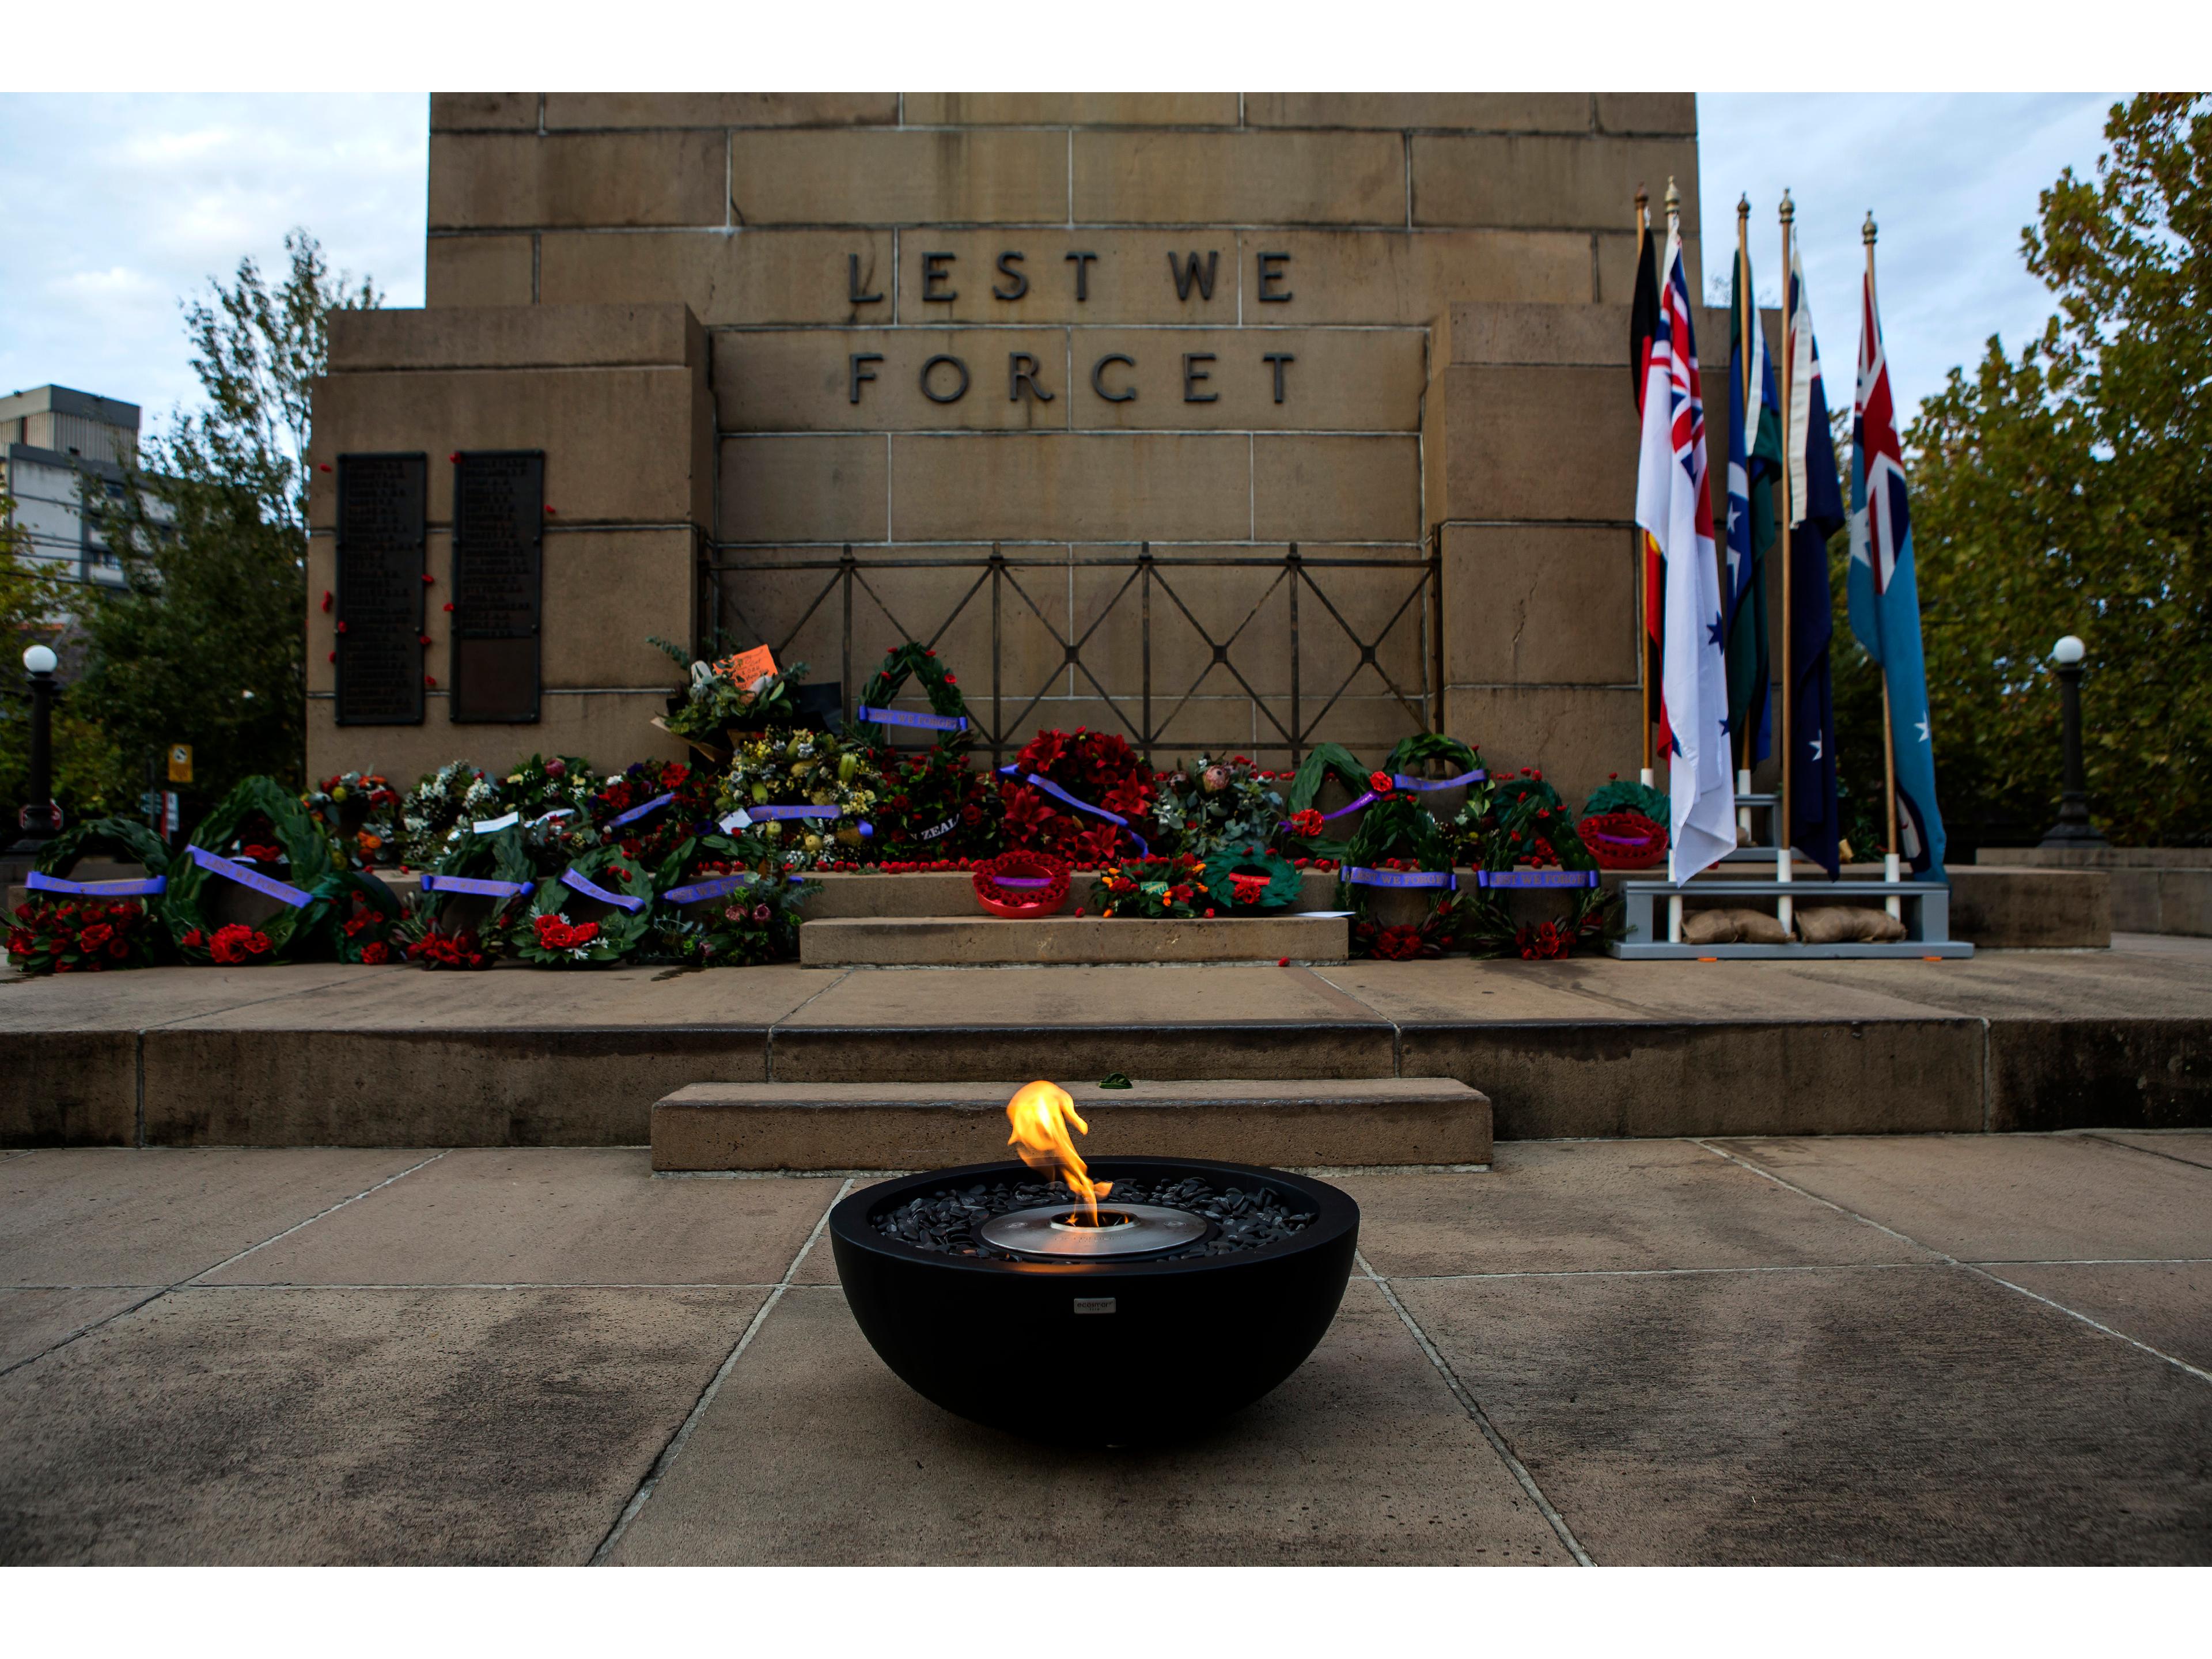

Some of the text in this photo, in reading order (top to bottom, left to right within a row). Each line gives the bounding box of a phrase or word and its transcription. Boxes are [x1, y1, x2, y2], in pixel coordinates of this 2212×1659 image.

[848, 250, 1294, 303] LEST WE
[849, 352, 1296, 404] FORGET
[921, 813, 960, 840] ZEAL
[696, 884, 717, 896] WE
[721, 878, 743, 893] FOR
[1382, 875, 1401, 885] WE
[1404, 874, 1448, 885] FORGET
[1521, 874, 1541, 885] WE
